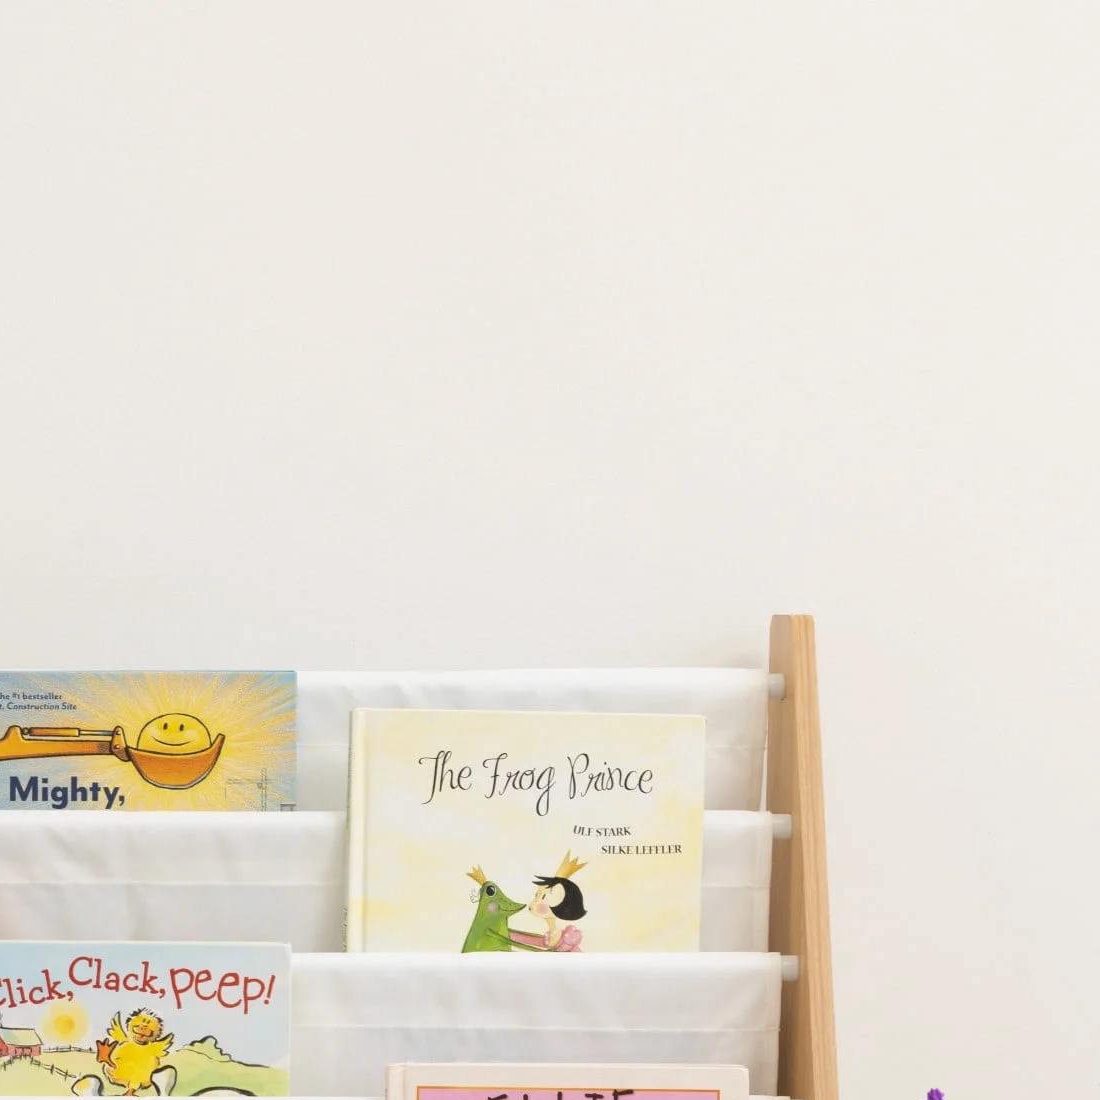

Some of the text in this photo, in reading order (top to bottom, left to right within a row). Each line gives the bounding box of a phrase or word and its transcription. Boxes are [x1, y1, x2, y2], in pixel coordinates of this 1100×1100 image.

[12, 691, 20, 700] #1
[22, 691, 62, 700] bestseller
[6, 702, 60, 710] Construction
[61, 702, 77, 710] Site
[418, 750, 654, 817] The Frog Prince
[9, 775, 126, 809] Mighty,
[573, 824, 632, 837] ULF STARK
[600, 844, 683, 855] SILKE LEFFLER
[68, 956, 167, 999] Clack,
